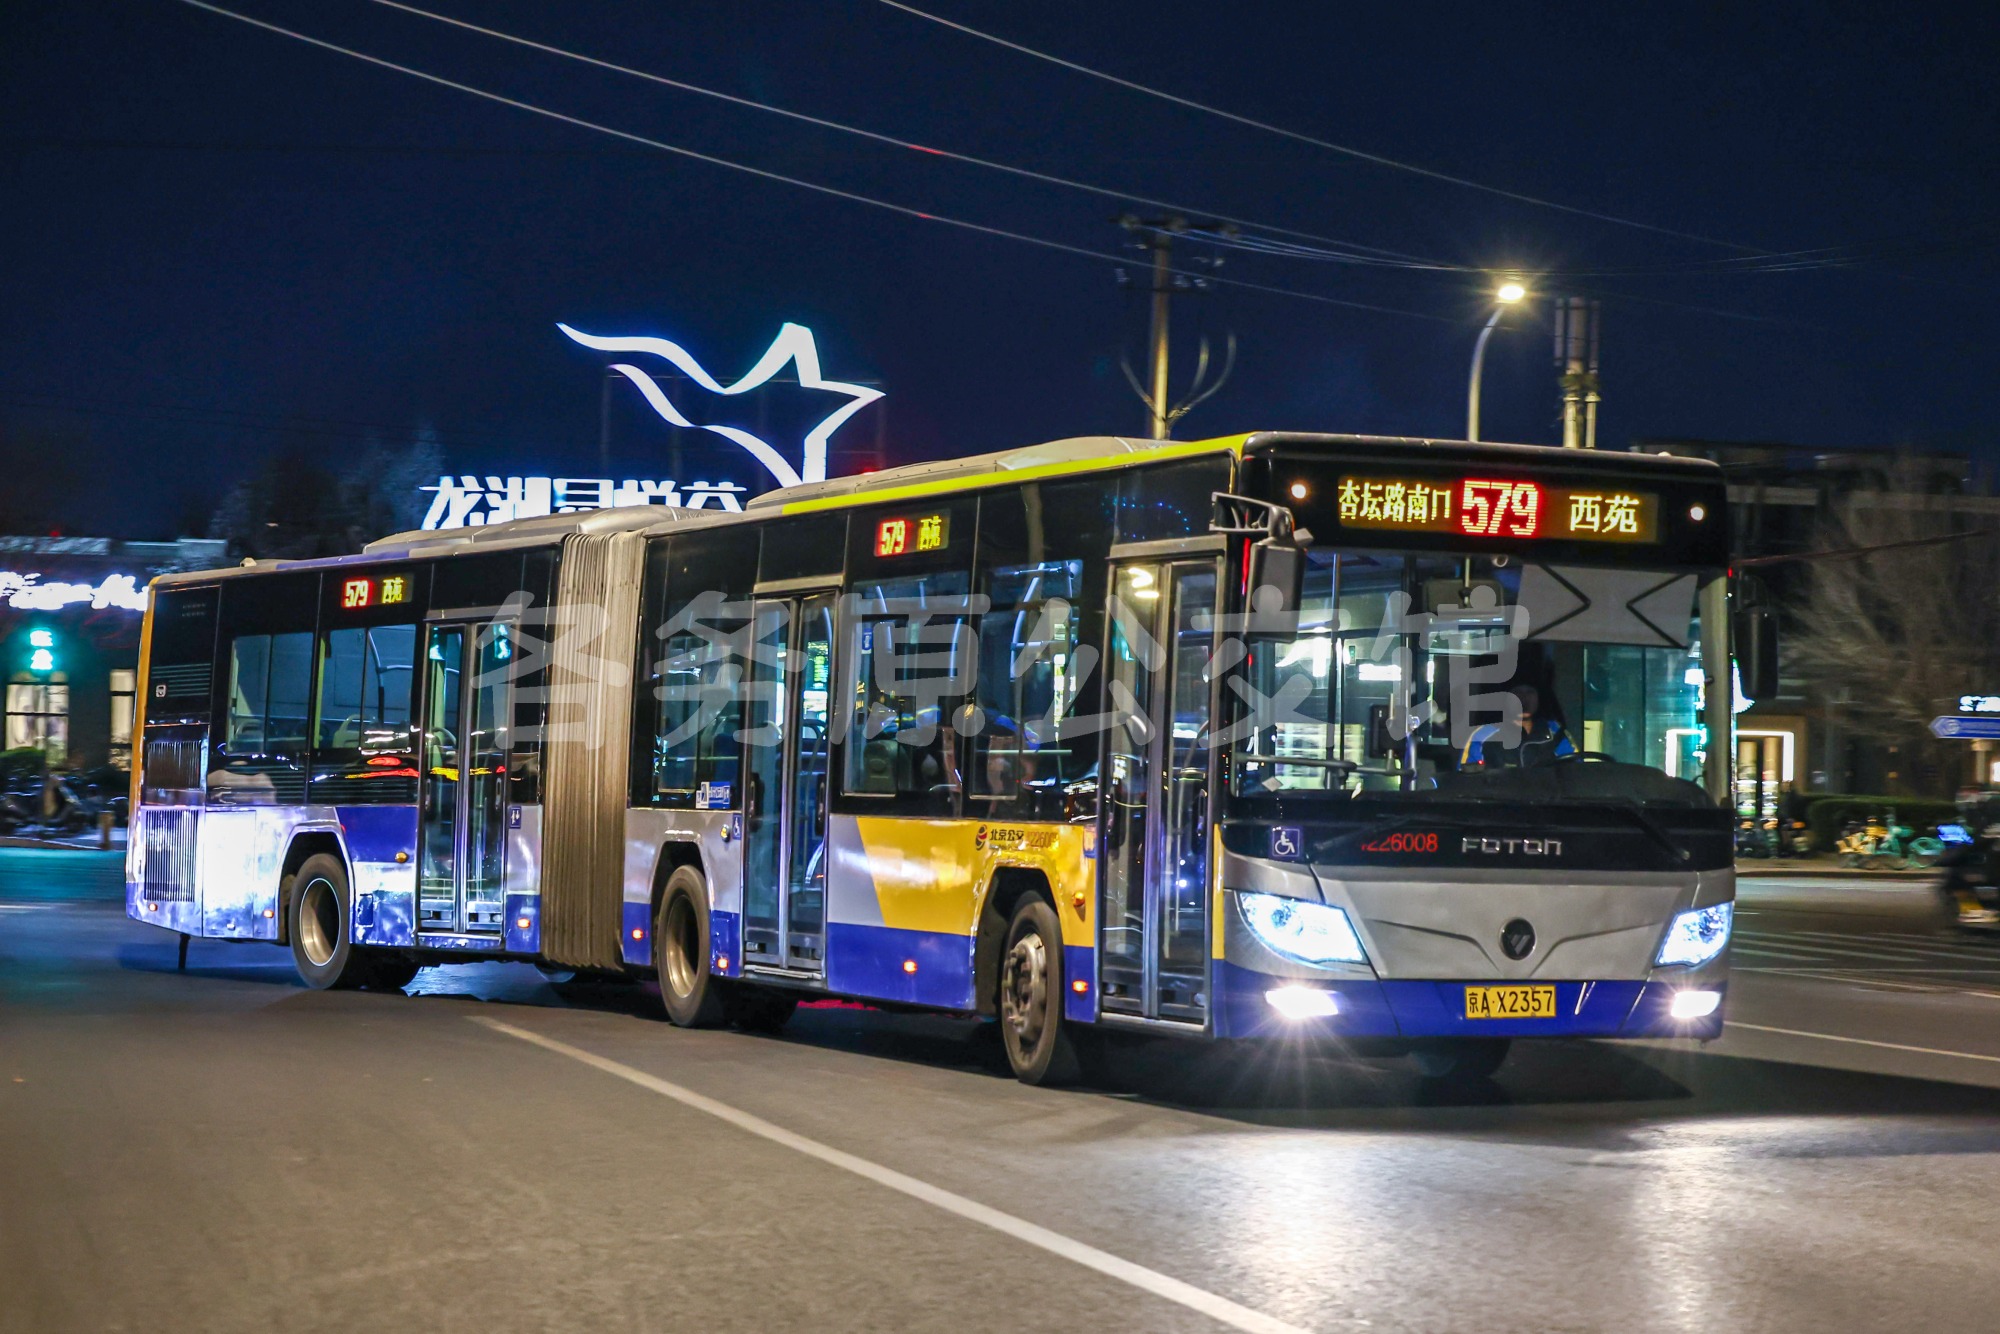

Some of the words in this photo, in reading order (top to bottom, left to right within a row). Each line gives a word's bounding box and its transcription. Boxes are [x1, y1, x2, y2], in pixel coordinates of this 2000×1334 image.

[1338, 479, 1451, 523] 杏坛路南口
[1461, 480, 1538, 535] 579
[1569, 494, 1639, 533] 西苑
[881, 520, 906, 555] 579
[345, 580, 369, 607] 579
[990, 828, 1025, 842] 北京公交
[1461, 837, 1562, 856] FOTON
